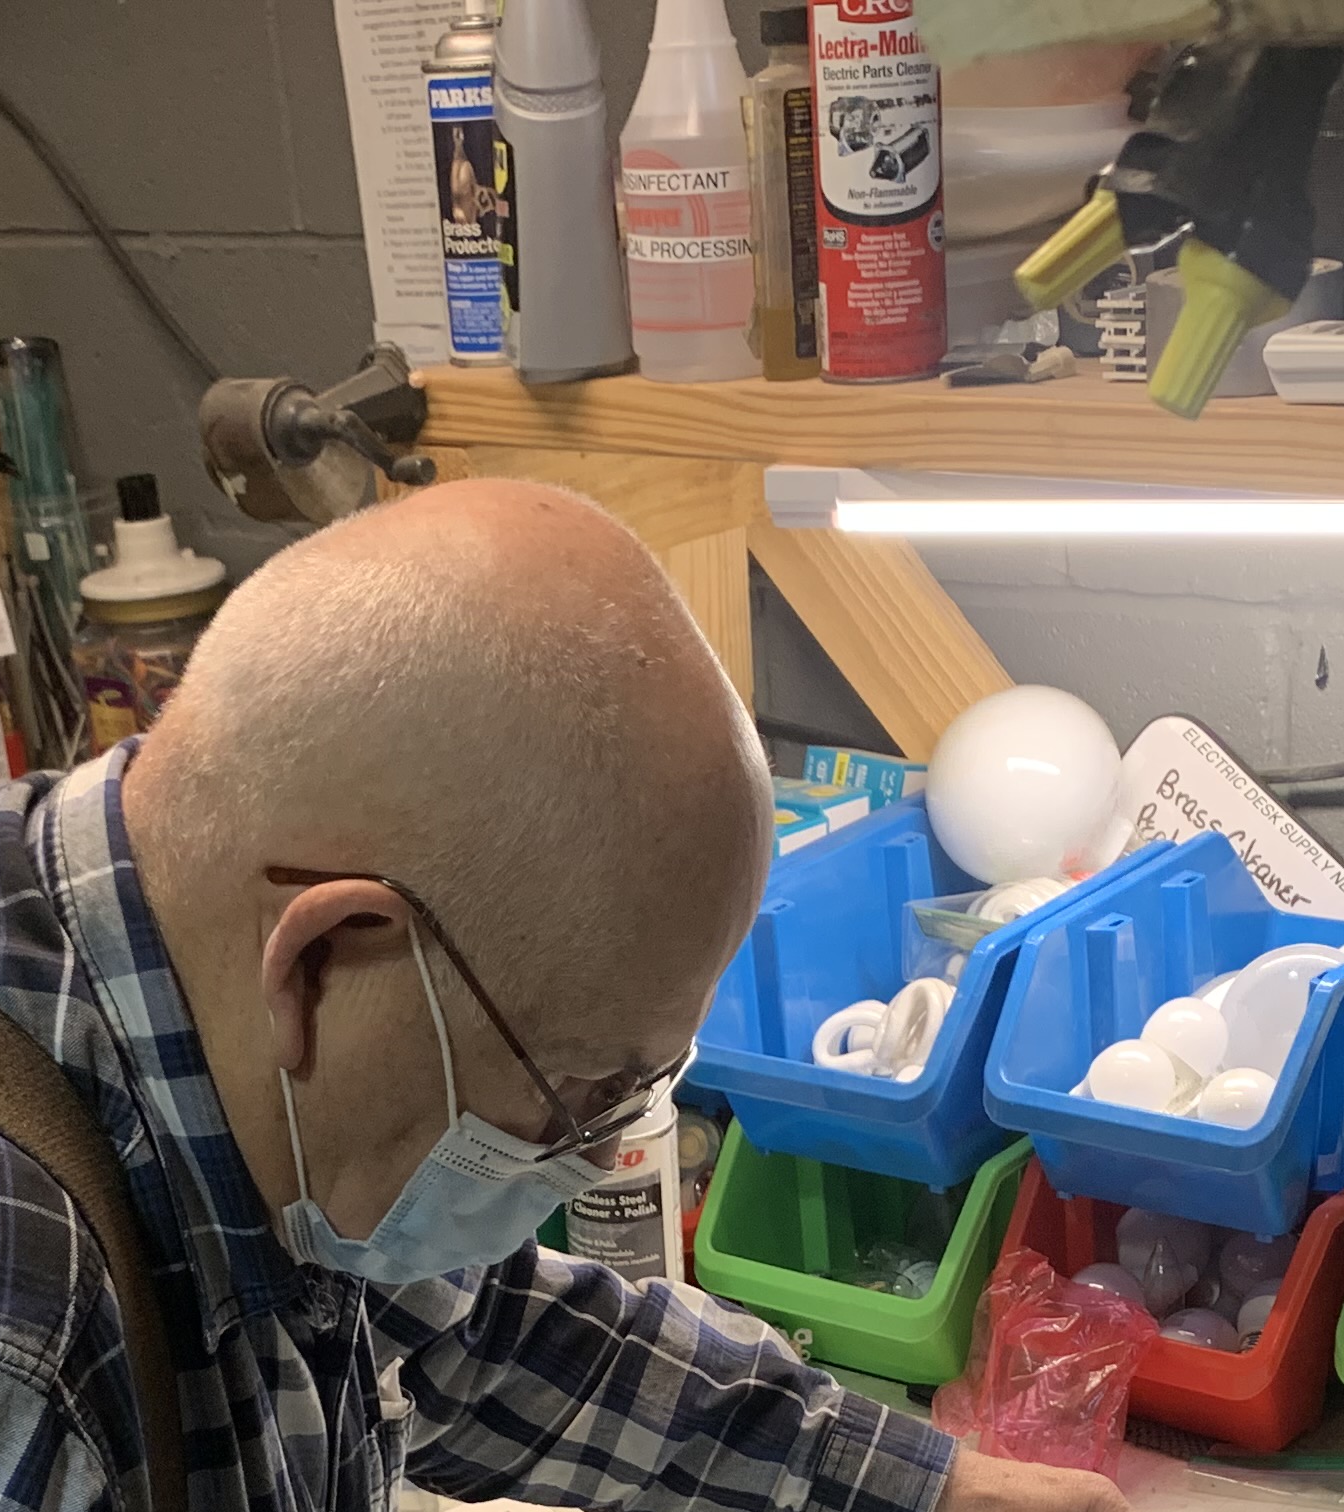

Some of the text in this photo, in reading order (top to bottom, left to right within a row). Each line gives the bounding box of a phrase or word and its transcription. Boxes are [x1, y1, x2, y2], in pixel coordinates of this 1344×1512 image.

[823, 65, 859, 81] Electric
[863, 64, 893, 78] Parts
[431, 87, 492, 109] PARKS
[847, 184, 918, 200] Non-Flammable
[443, 220, 482, 237] Brass
[444, 237, 501, 255] Protecto
[651, 239, 754, 259] PROCESSIN
[1182, 727, 1249, 791] ELECTRIC
[1243, 787, 1285, 826] DESK
[1279, 822, 1336, 873] SUPPLY
[618, 1191, 646, 1205] Steel
[624, 1203, 657, 1218] Polish
